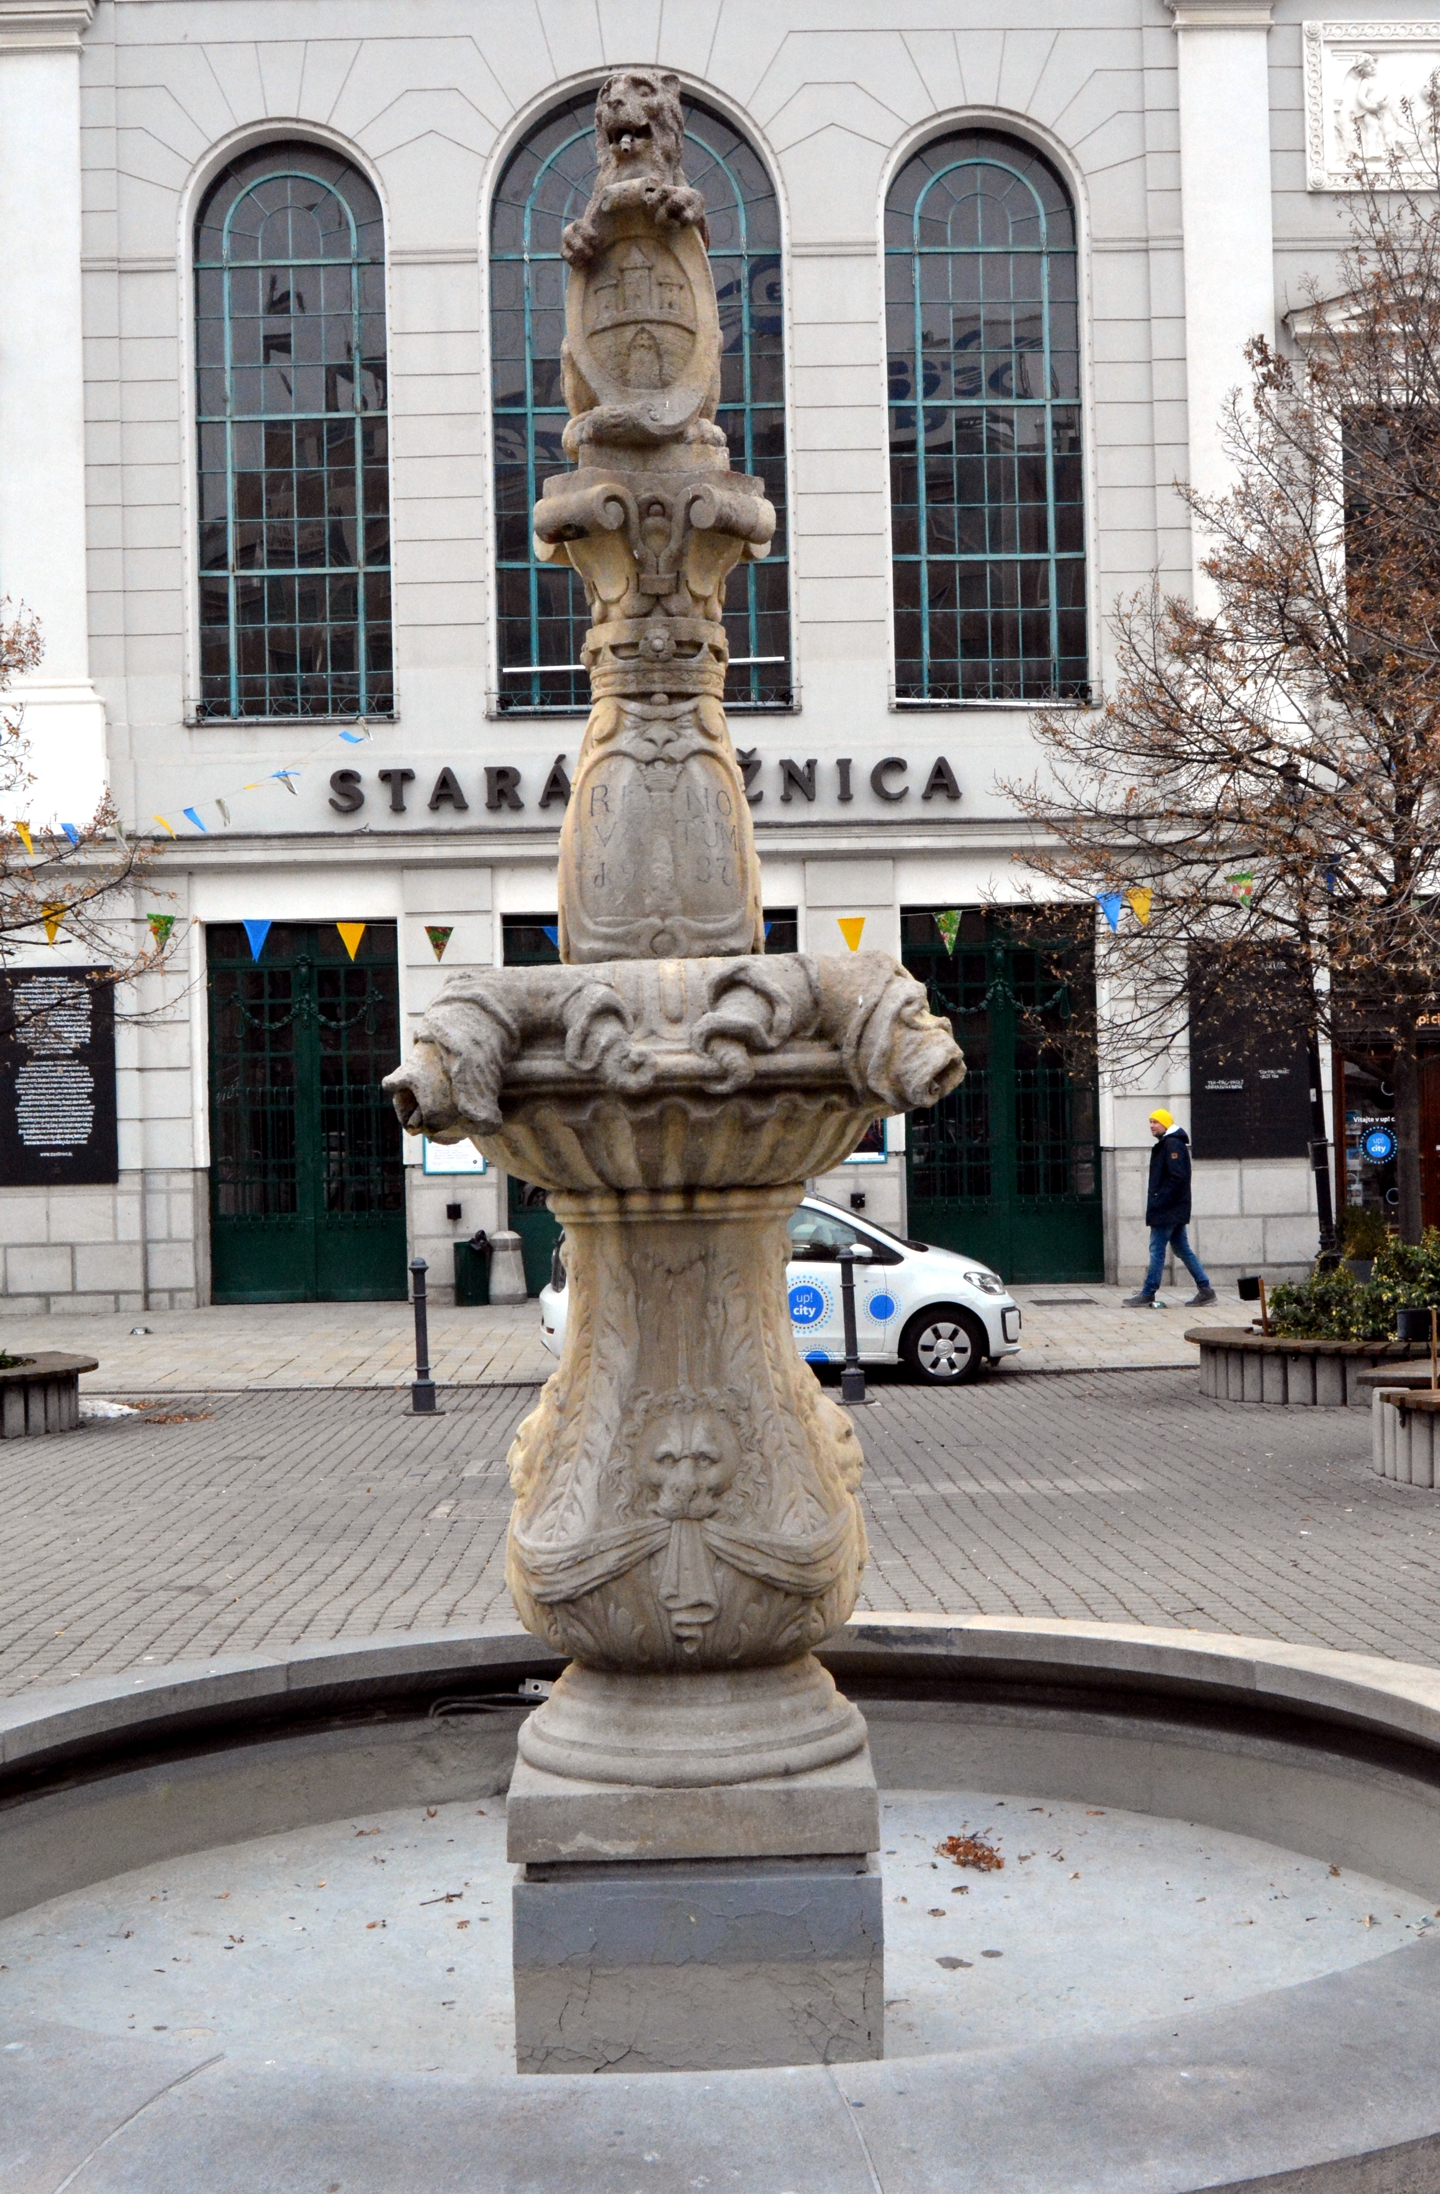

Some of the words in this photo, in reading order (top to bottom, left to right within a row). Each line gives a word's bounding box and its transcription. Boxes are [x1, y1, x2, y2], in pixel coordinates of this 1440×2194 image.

[328, 753, 571, 812] STARÁ
[736, 746, 963, 804] ŽNICA
[1416, 1013, 1430, 1027] p!
[1353, 1116, 1375, 1124] Vitajte
[1380, 1116, 1391, 1124] up!
[1372, 1137, 1385, 1145] up!
[1371, 1144, 1386, 1154] city
[796, 1292, 814, 1304] up!
[793, 1305, 817, 1317] city
